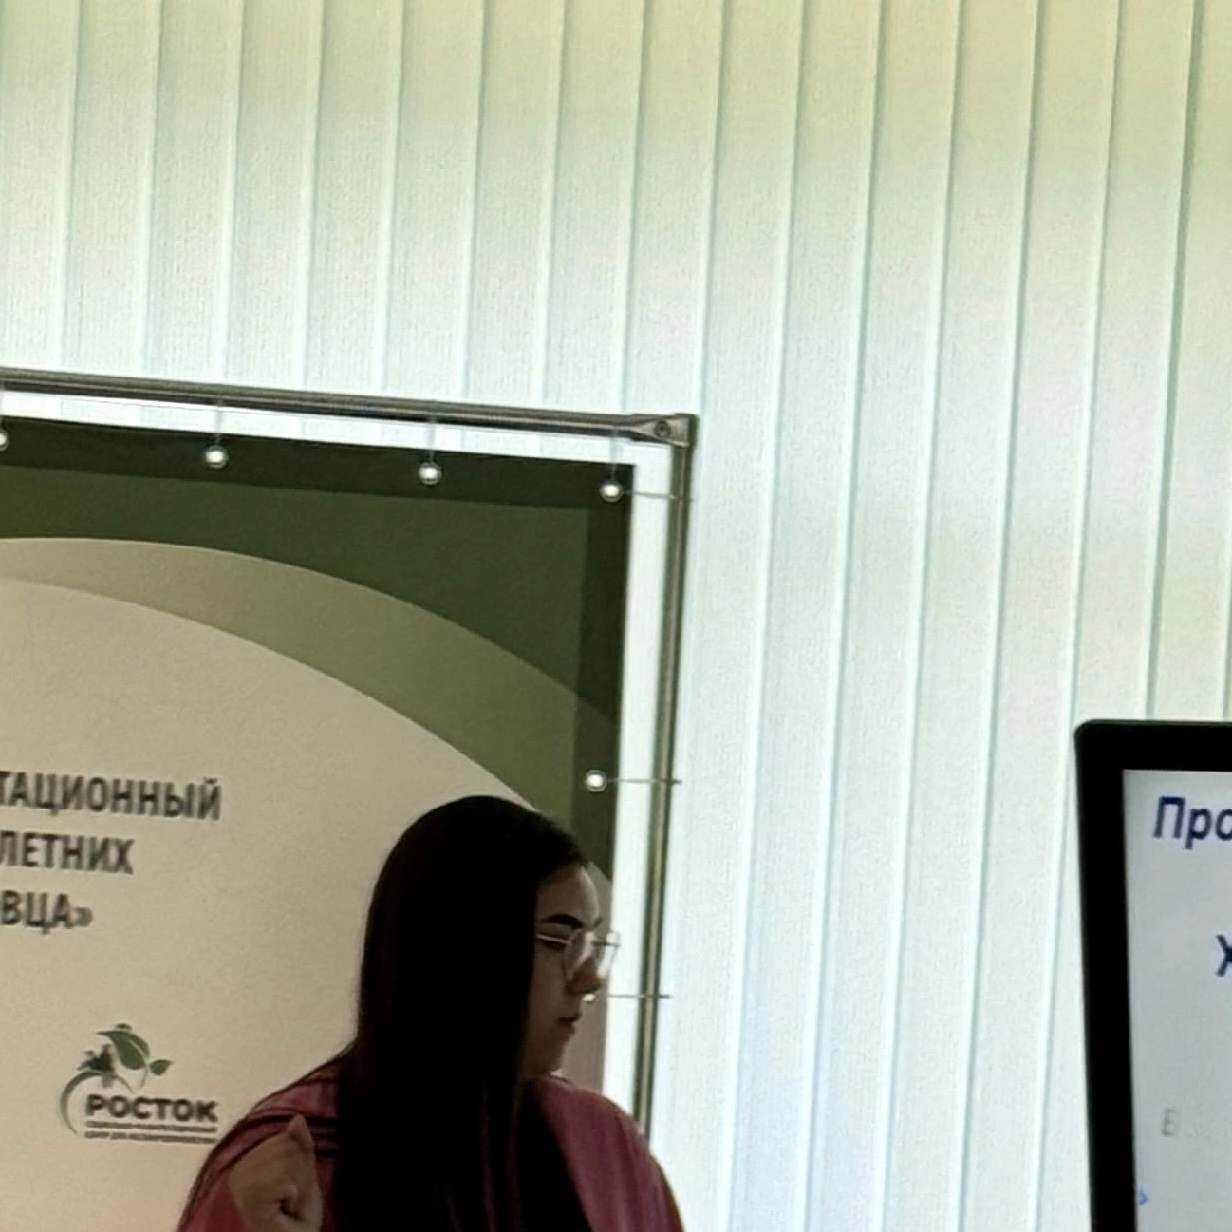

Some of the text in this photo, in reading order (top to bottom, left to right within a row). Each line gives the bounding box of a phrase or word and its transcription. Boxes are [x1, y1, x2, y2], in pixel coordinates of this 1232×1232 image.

[0, 830, 135, 875] ЛЕТНИХ
[0, 889, 94, 936] ВЦА»
[85, 1093, 219, 1123] РОСТОК
